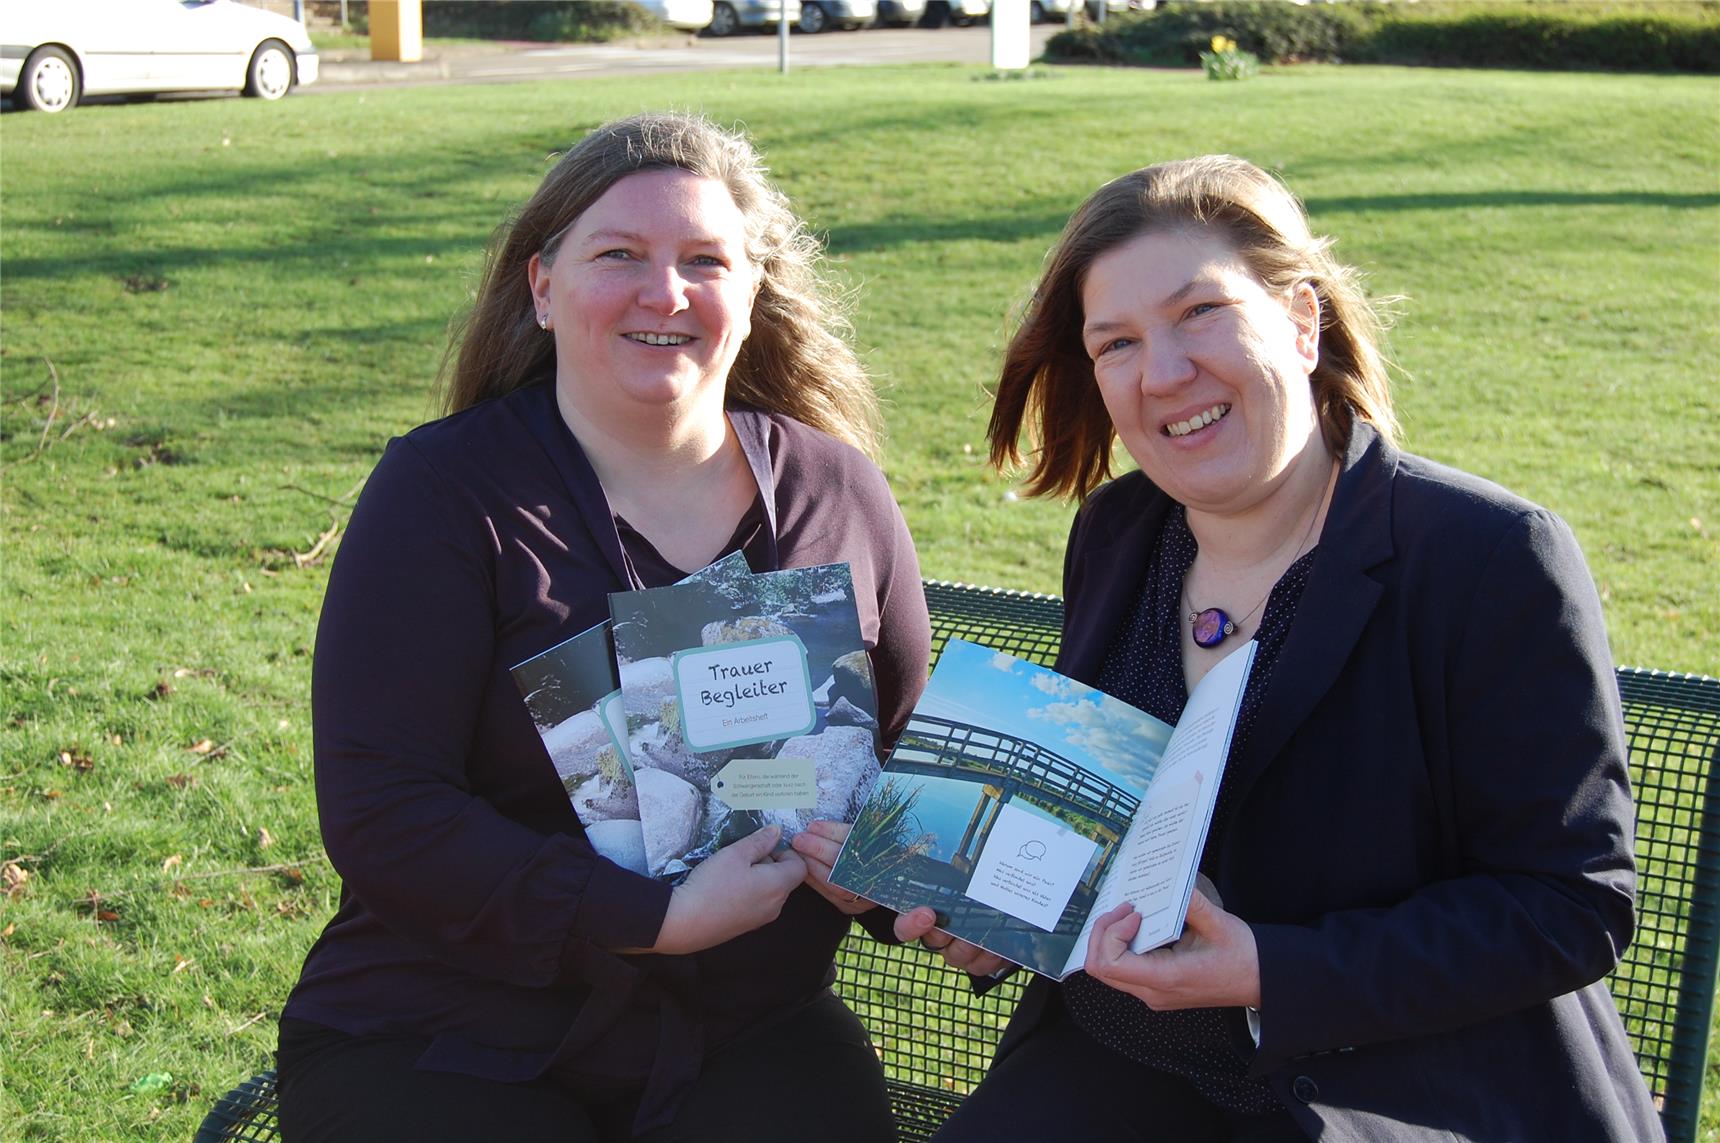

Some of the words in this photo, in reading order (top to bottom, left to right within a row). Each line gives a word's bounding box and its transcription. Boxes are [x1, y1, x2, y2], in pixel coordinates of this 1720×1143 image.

[708, 660, 773, 680] Trauer
[701, 680, 787, 708] Begleiter
[722, 719, 733, 727] Ein
[734, 713, 768, 725] Arbeitsheft
